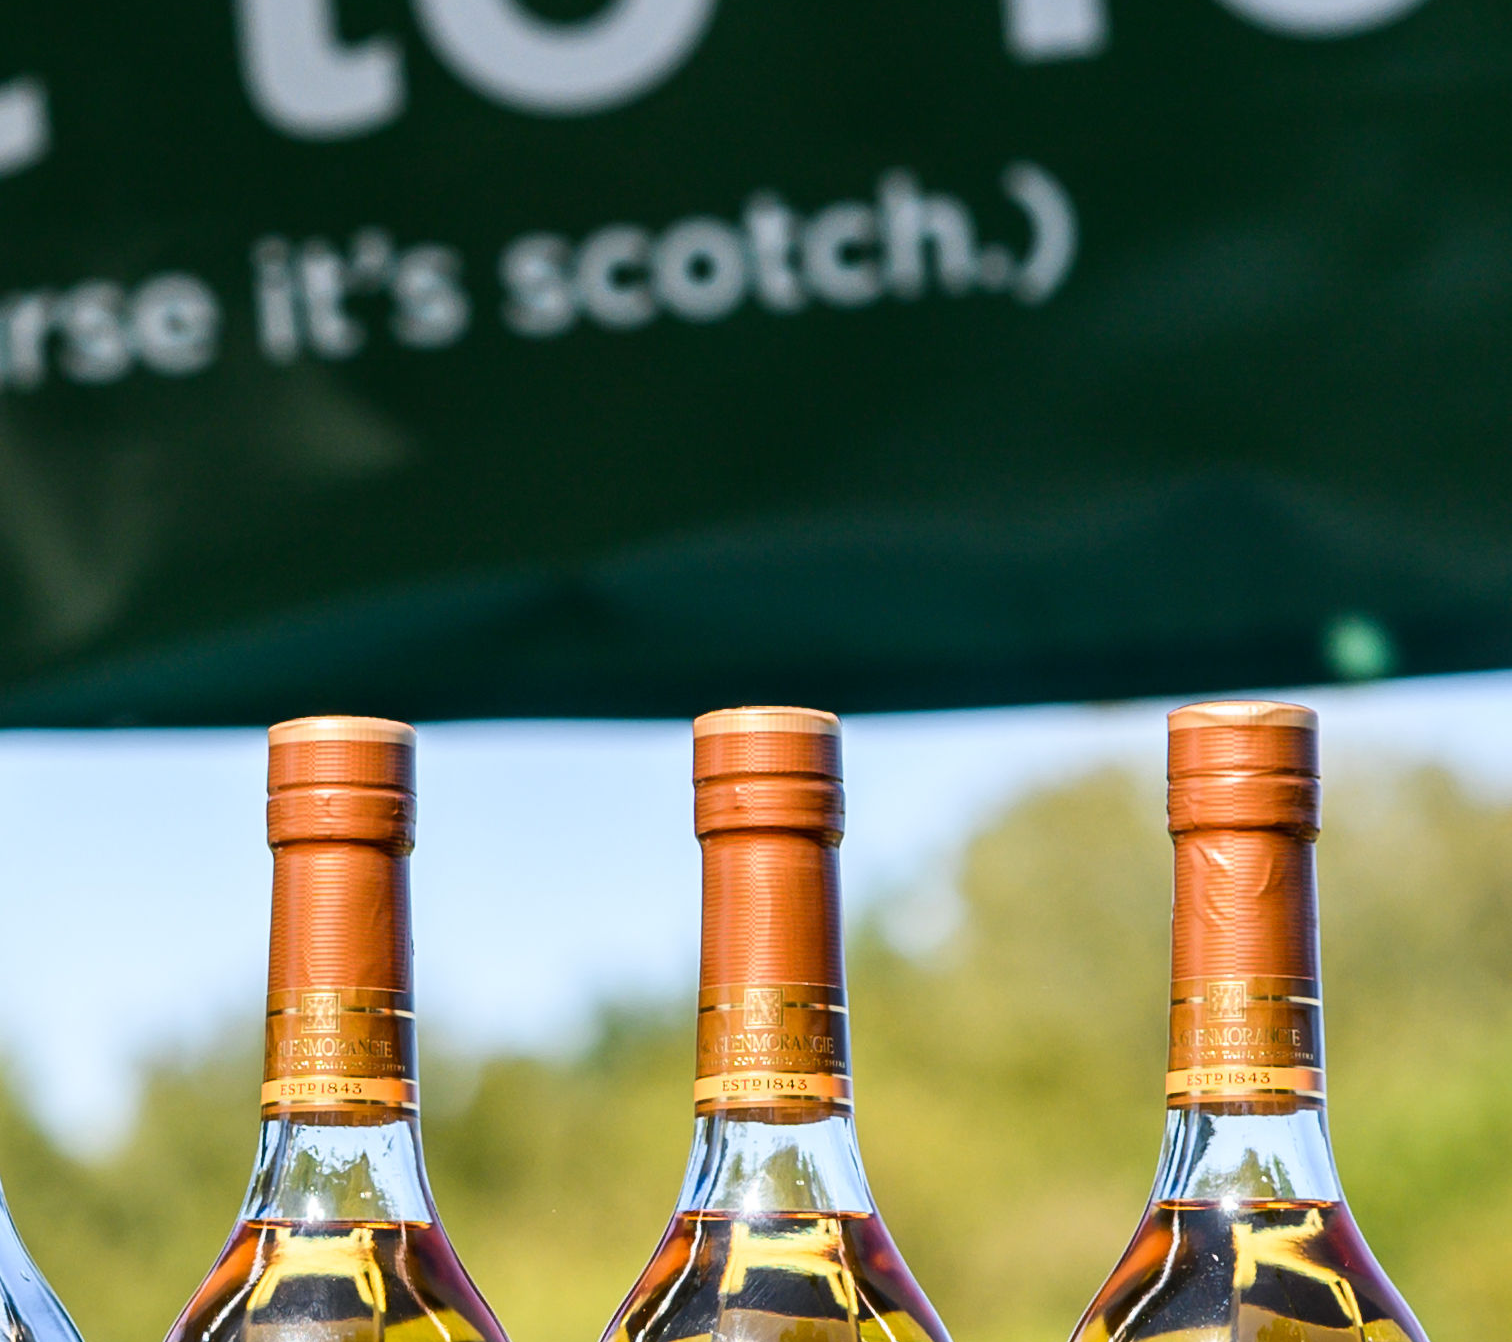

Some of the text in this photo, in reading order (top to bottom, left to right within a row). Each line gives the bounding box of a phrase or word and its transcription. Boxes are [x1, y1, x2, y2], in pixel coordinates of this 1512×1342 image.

[252, 226, 471, 363] it's
[500, 162, 1078, 337] scotch.)
[1229, 1073, 1270, 1084] 1843
[321, 1083, 362, 1094] 1843
[767, 1079, 807, 1090] 1843
